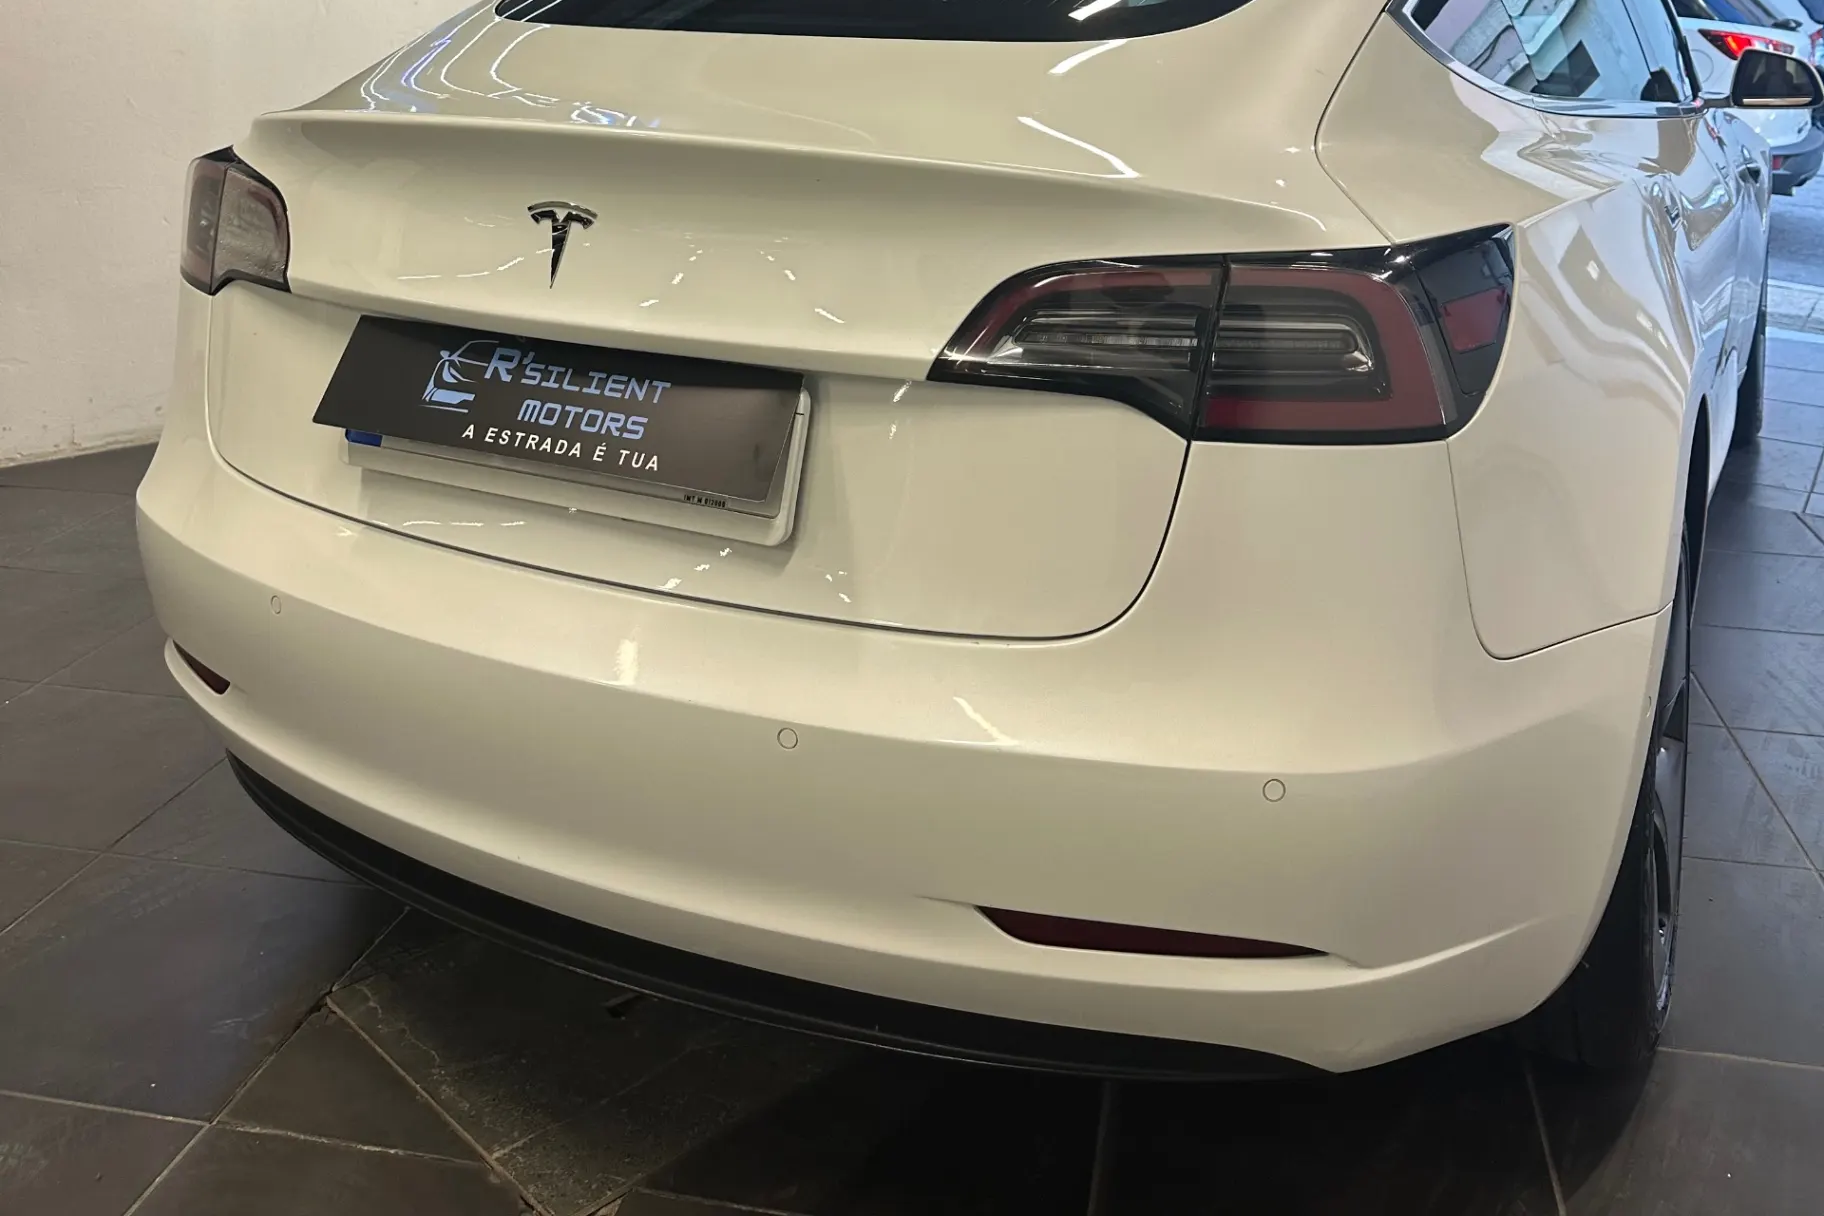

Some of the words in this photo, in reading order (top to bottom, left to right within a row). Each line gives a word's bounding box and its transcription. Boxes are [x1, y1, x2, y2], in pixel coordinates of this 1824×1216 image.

[517, 399, 649, 440] MOTORS
[461, 424, 475, 440] A
[484, 427, 582, 458] ESTRADA
[592, 442, 607, 462] É
[617, 449, 659, 471] TUA
